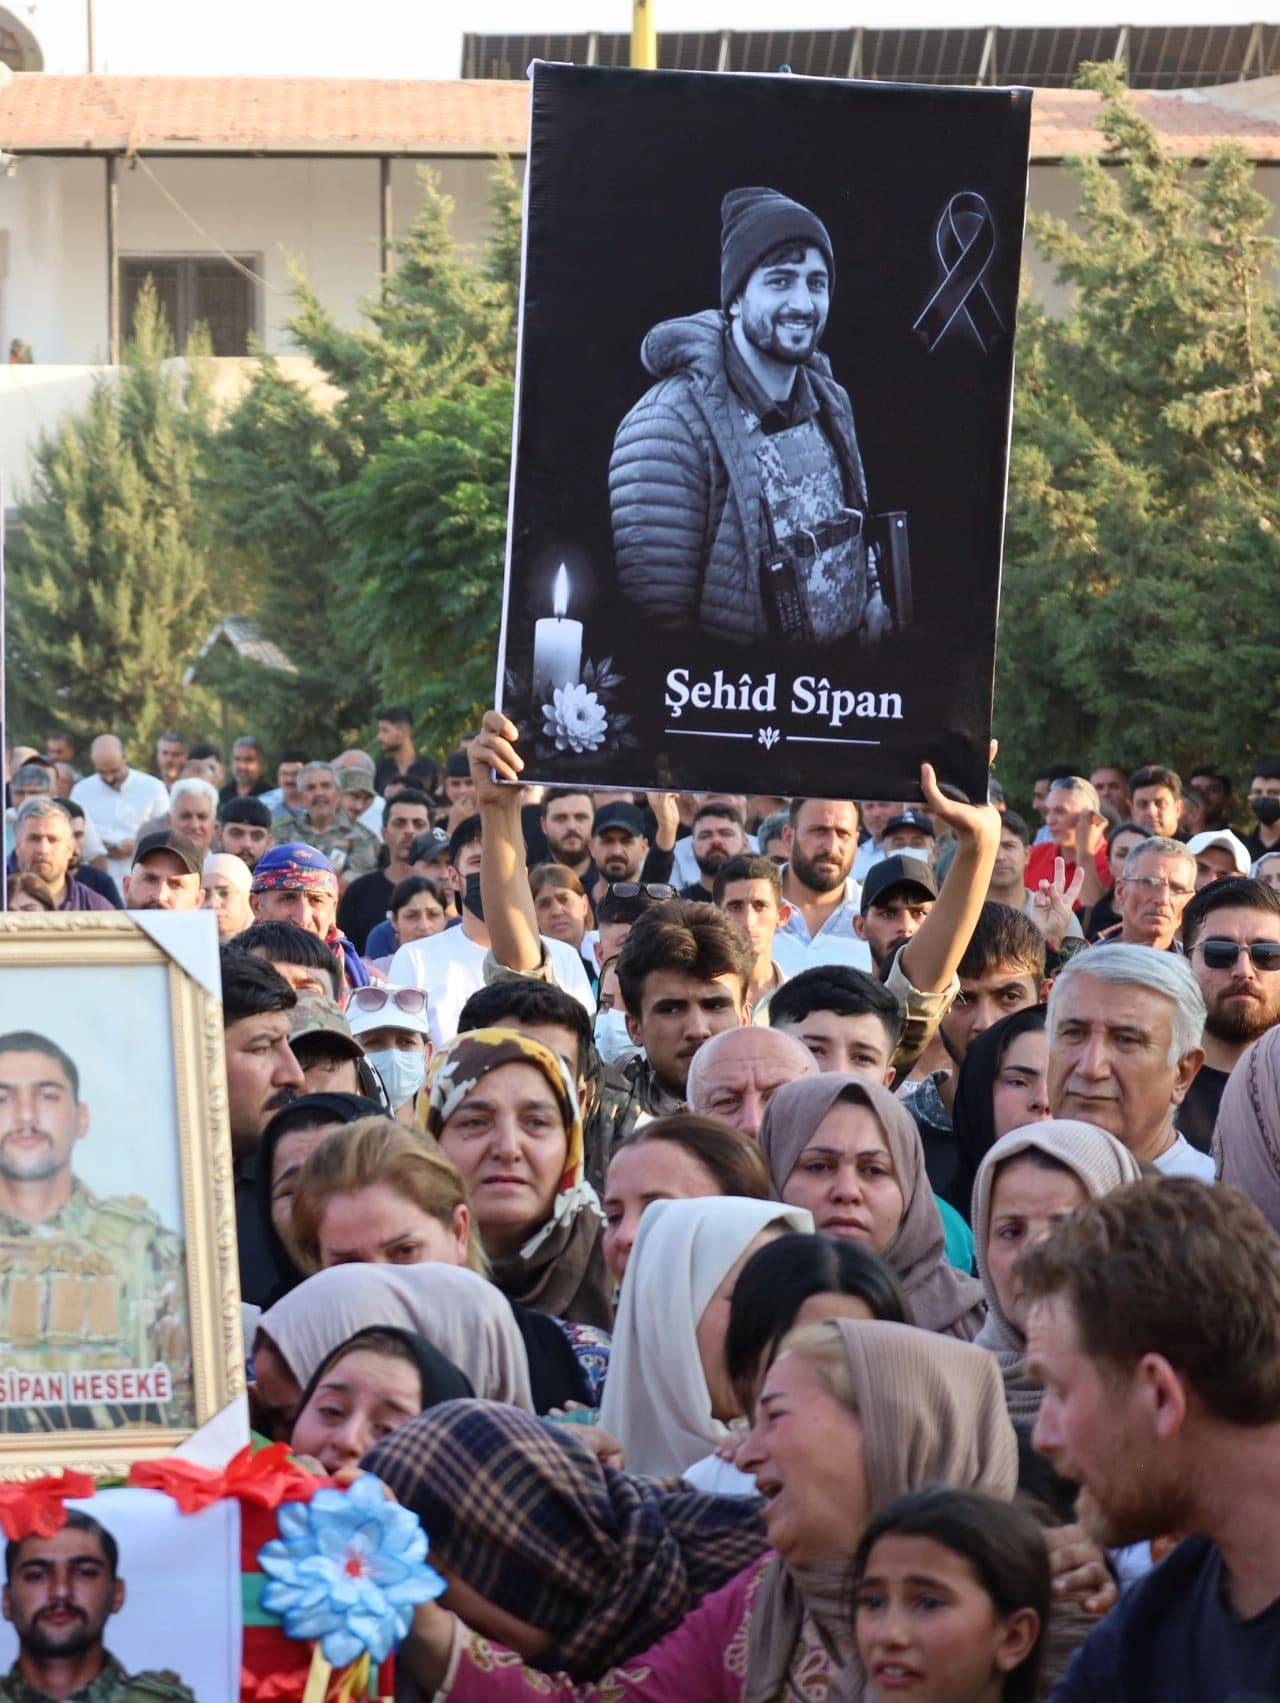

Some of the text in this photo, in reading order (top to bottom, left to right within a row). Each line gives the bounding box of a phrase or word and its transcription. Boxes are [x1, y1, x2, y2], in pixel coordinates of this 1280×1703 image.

[664, 667, 903, 727] Şehîd Sîpan
[72, 1365, 169, 1401] HESEKÊ
